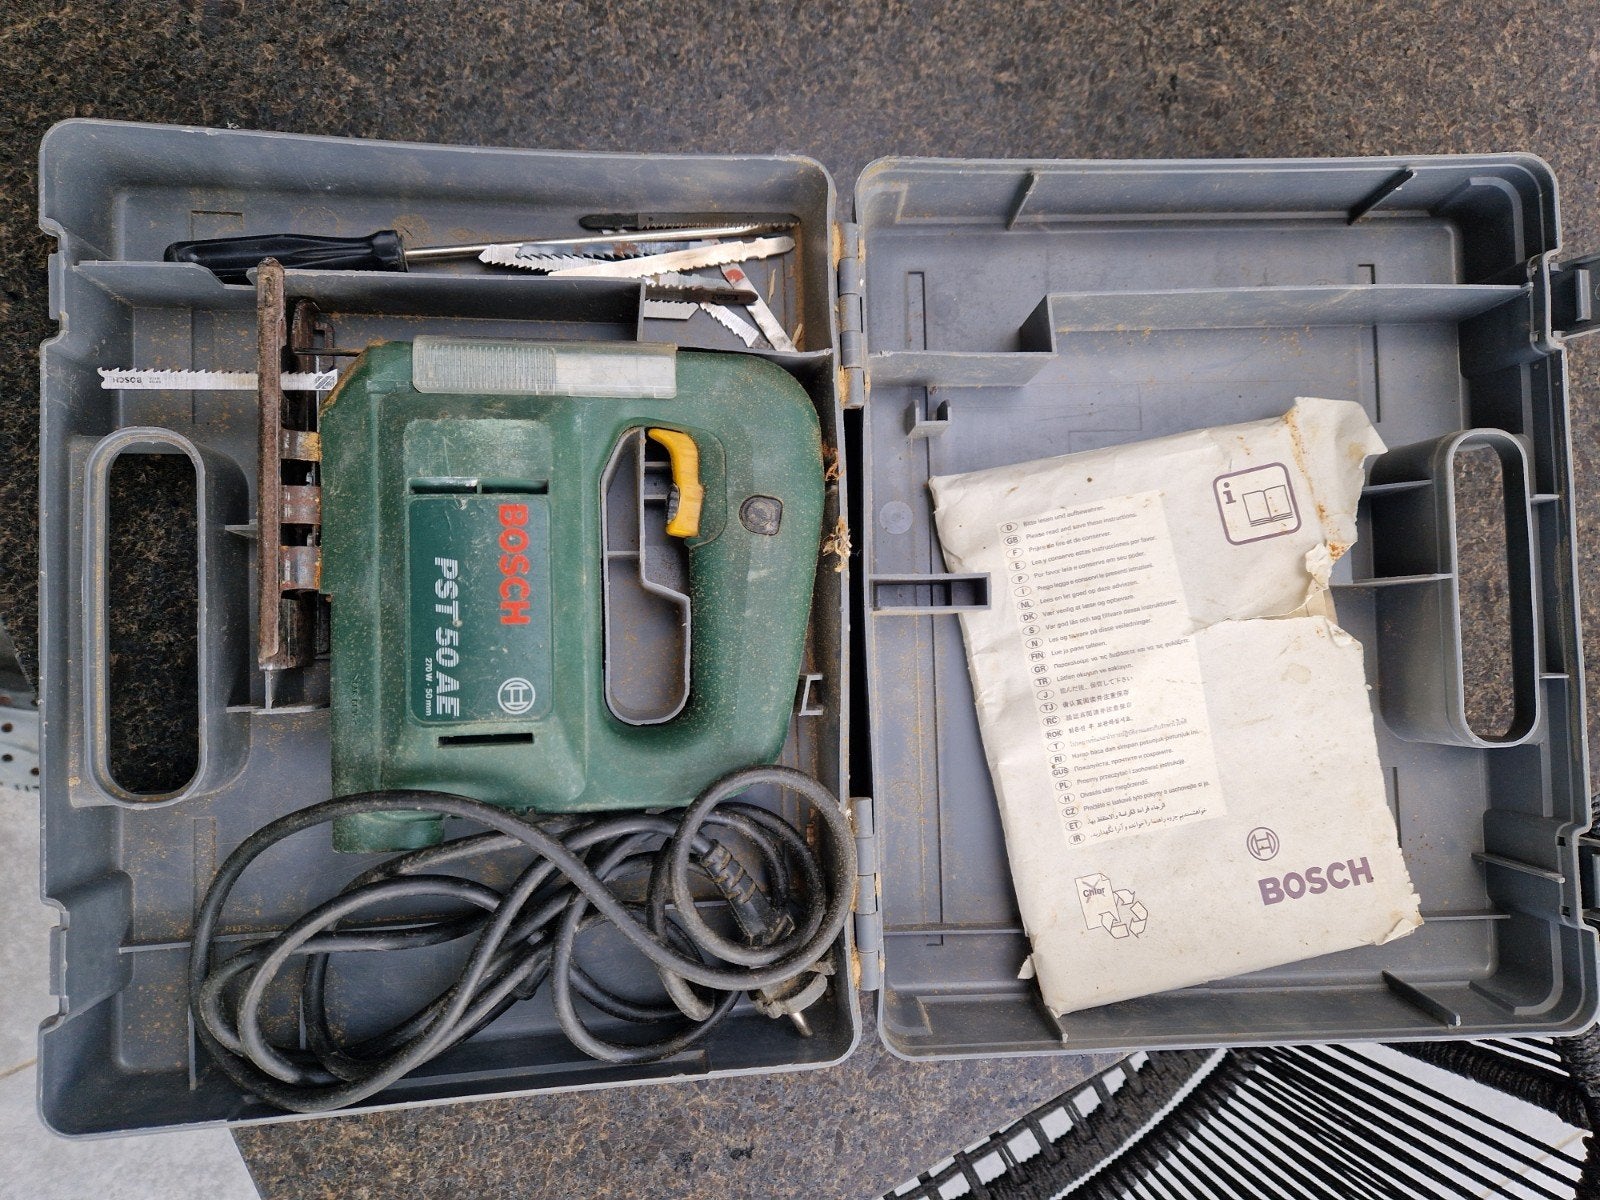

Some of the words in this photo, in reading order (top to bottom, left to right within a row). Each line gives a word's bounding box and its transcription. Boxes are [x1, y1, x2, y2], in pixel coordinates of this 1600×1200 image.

[1026, 531, 1045, 540] Please
[1046, 528, 1060, 536] read
[1006, 537, 1018, 545] GB
[498, 504, 531, 625] BOSCH
[434, 557, 459, 621] PST
[1021, 601, 1031, 609] NL
[435, 627, 460, 668] 50
[1031, 652, 1044, 660] FIN
[425, 657, 433, 672] 270
[436, 671, 460, 717] AE
[1046, 717, 1058, 725] RC
[1047, 730, 1062, 738] ROK
[1054, 768, 1069, 776] GUS
[1258, 857, 1374, 906] BOSCH
